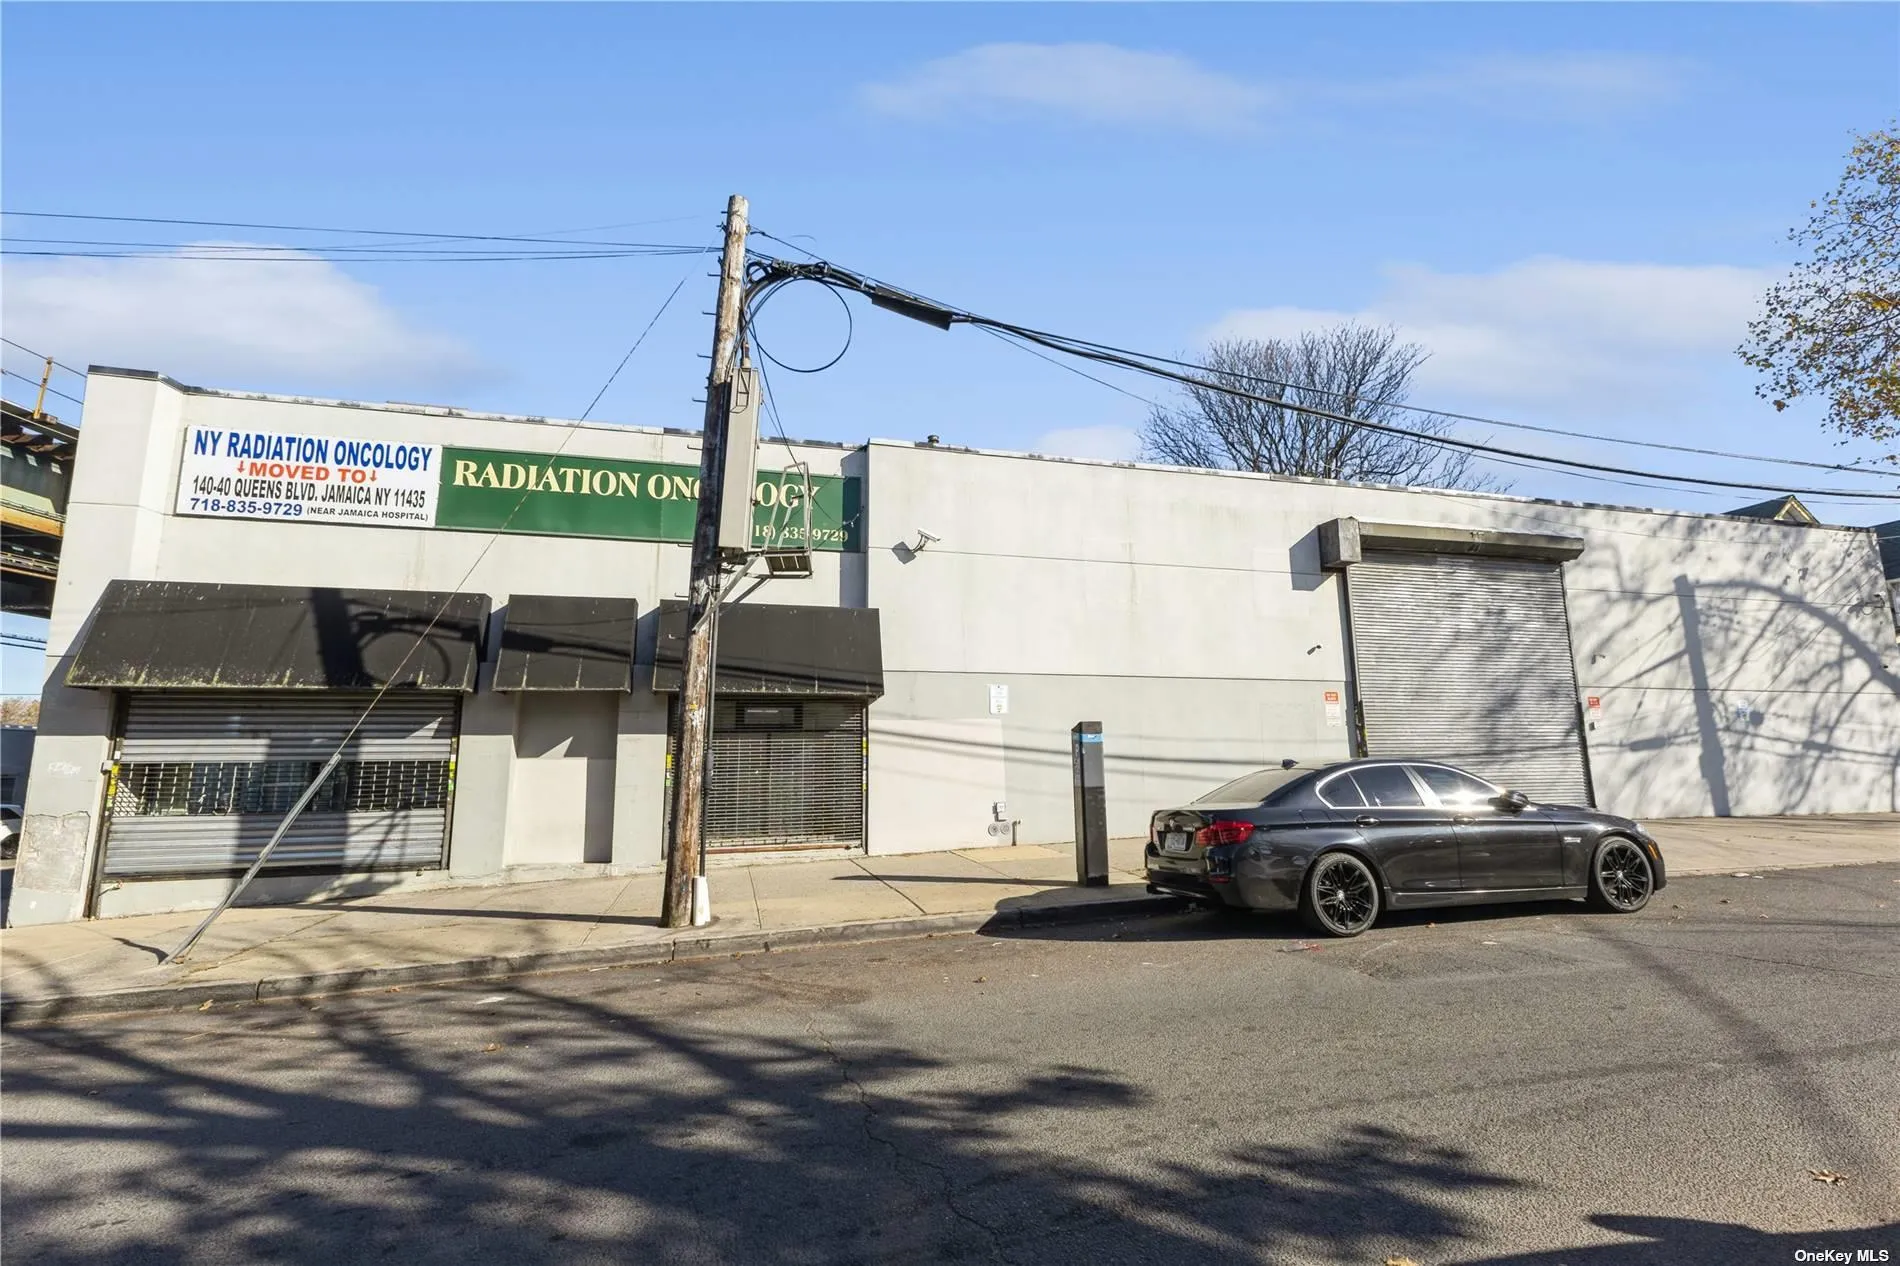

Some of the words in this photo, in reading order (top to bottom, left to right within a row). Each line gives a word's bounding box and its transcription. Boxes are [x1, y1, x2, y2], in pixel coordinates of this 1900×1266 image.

[194, 430, 222, 456] NY
[227, 432, 328, 464] RADIATION
[334, 440, 432, 471] ONCOLOGY
[249, 462, 330, 481] MOVED
[338, 468, 366, 484] TO
[452, 460, 641, 498] RADIATION
[647, 474, 820, 509] ONOGY
[194, 475, 231, 496] 140-40
[234, 478, 282, 500] QUEENS
[285, 482, 318, 501] BLVD.
[321, 484, 371, 505] JAMAICA
[374, 488, 392, 506] NY
[394, 488, 426, 508] 11435
[190, 498, 302, 516] 718-835-9729
[306, 506, 336, 516] (NEAR
[338, 508, 378, 518] JAMAICA
[382, 511, 428, 522] HOSPITAL)
